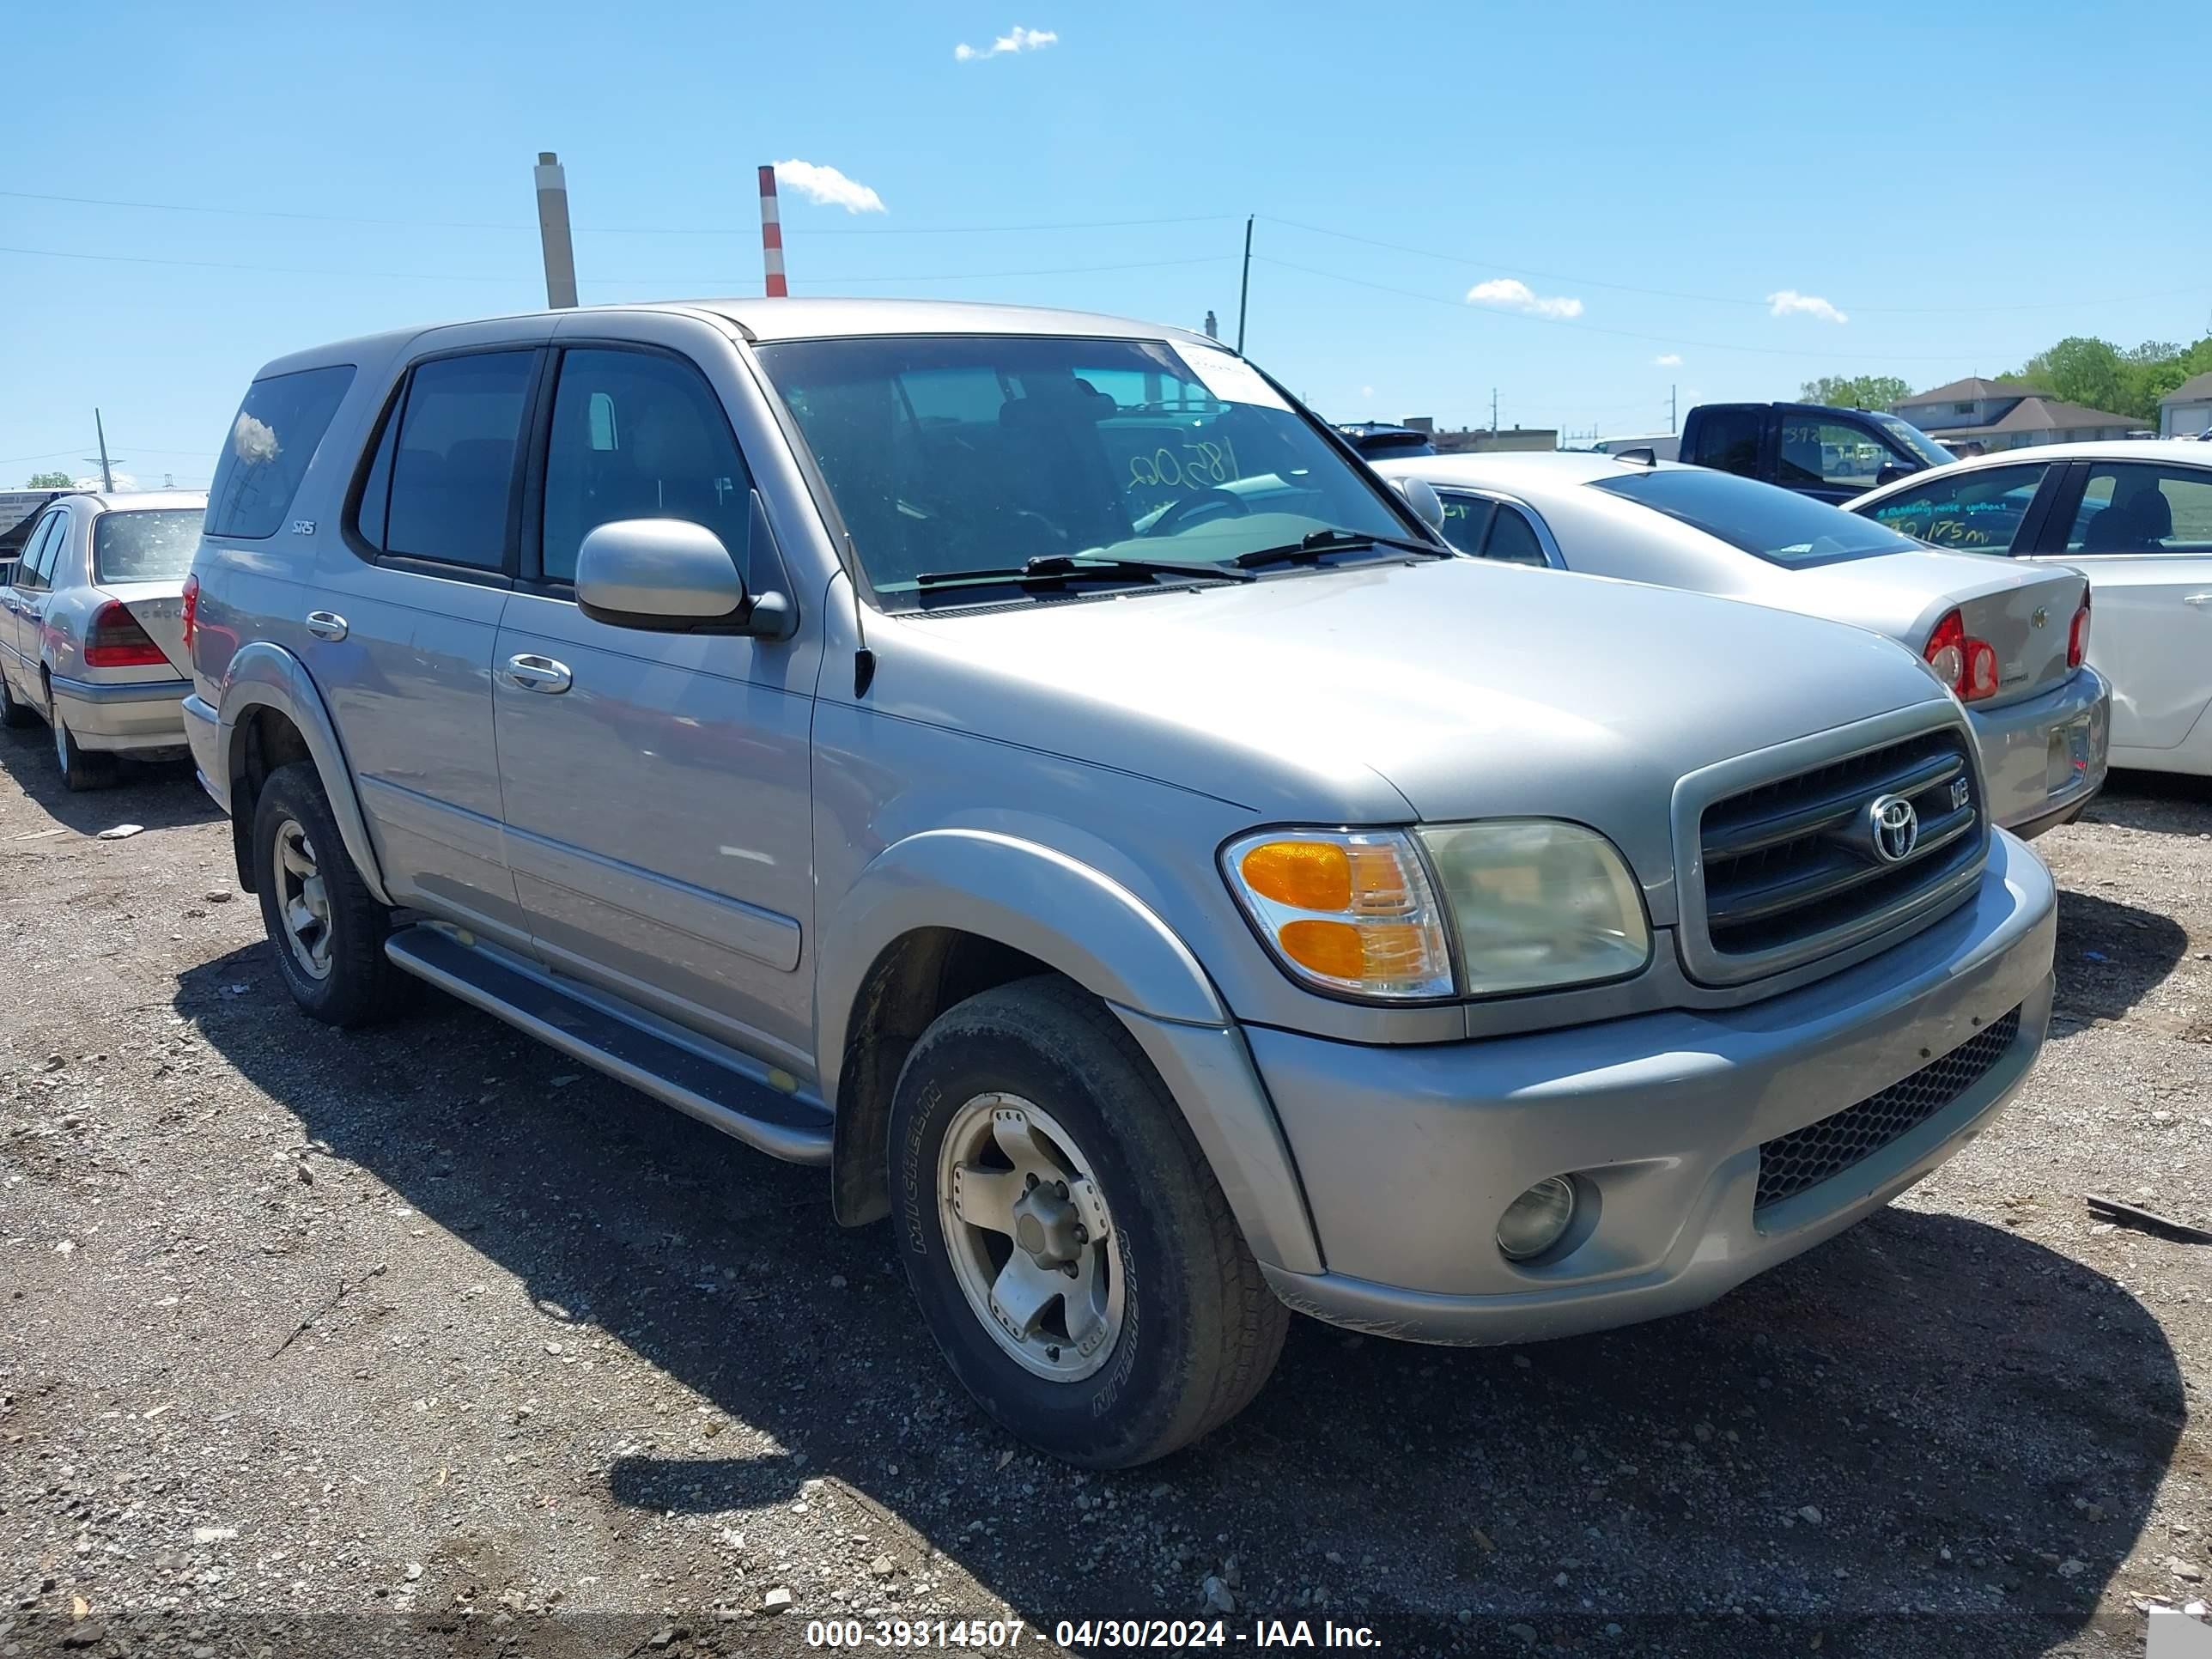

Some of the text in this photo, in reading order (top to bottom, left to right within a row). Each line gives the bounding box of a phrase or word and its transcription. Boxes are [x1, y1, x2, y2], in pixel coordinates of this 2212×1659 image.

[292, 520, 317, 536] SR5
[1950, 776, 1970, 810] V8
[904, 1079, 943, 1255] MICHELIN
[1091, 1226, 1140, 1418] MICHELIN
